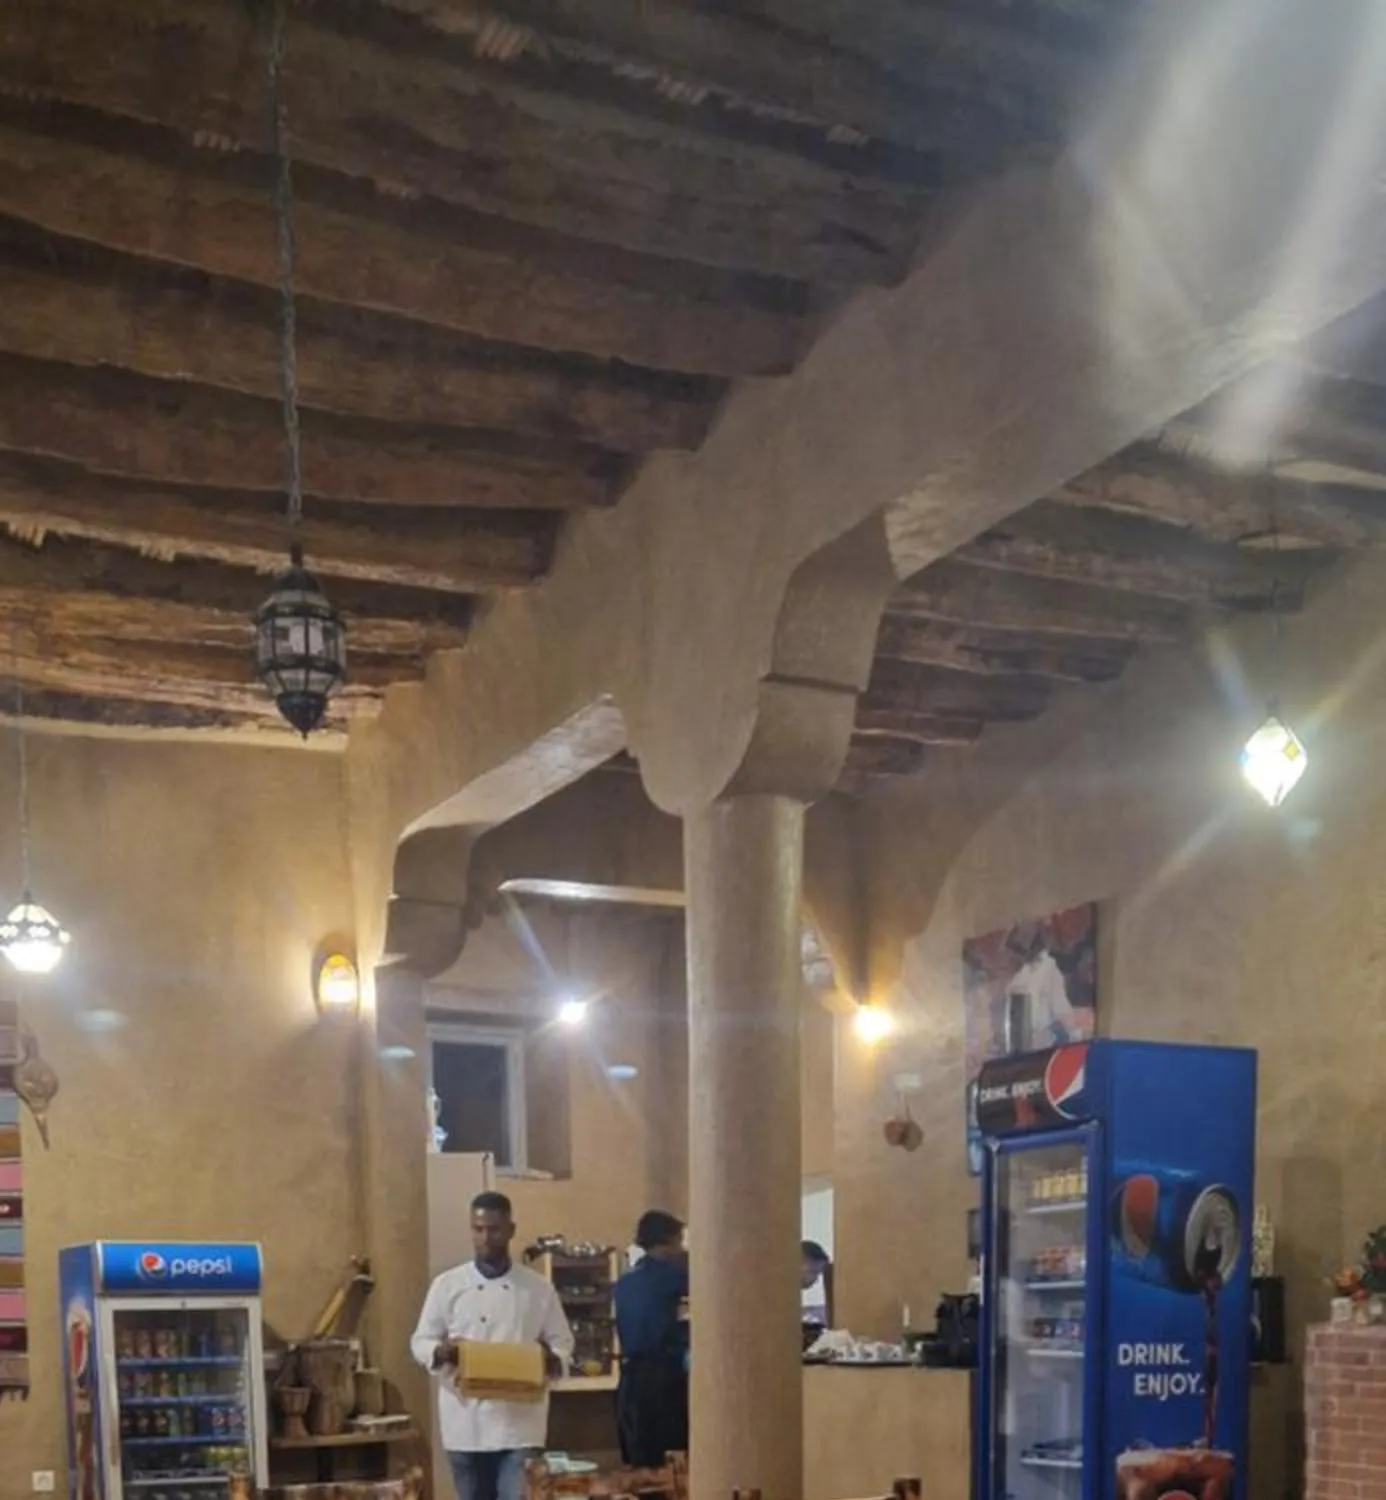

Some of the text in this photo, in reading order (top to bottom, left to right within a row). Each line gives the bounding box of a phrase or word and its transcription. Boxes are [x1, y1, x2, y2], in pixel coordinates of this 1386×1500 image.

[170, 1255, 233, 1279] pepsi
[1117, 1343, 1191, 1366] DRINK.
[1134, 1372, 1206, 1402] ENJOY.
